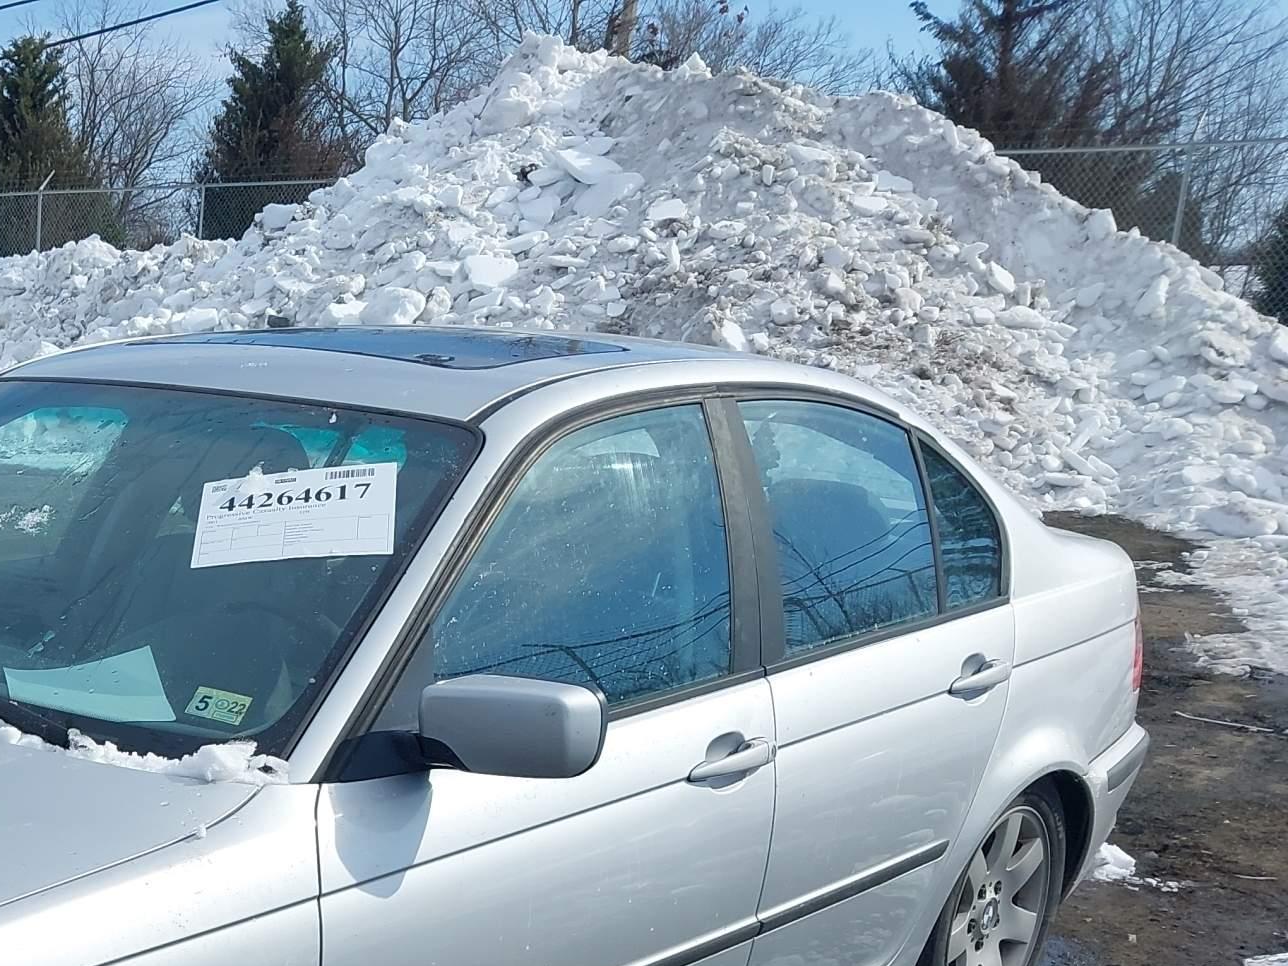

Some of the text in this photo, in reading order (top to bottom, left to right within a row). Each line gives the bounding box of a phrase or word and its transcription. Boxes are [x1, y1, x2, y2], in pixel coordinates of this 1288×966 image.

[219, 482, 372, 512] 44264617
[194, 694, 248, 716] 5 22
